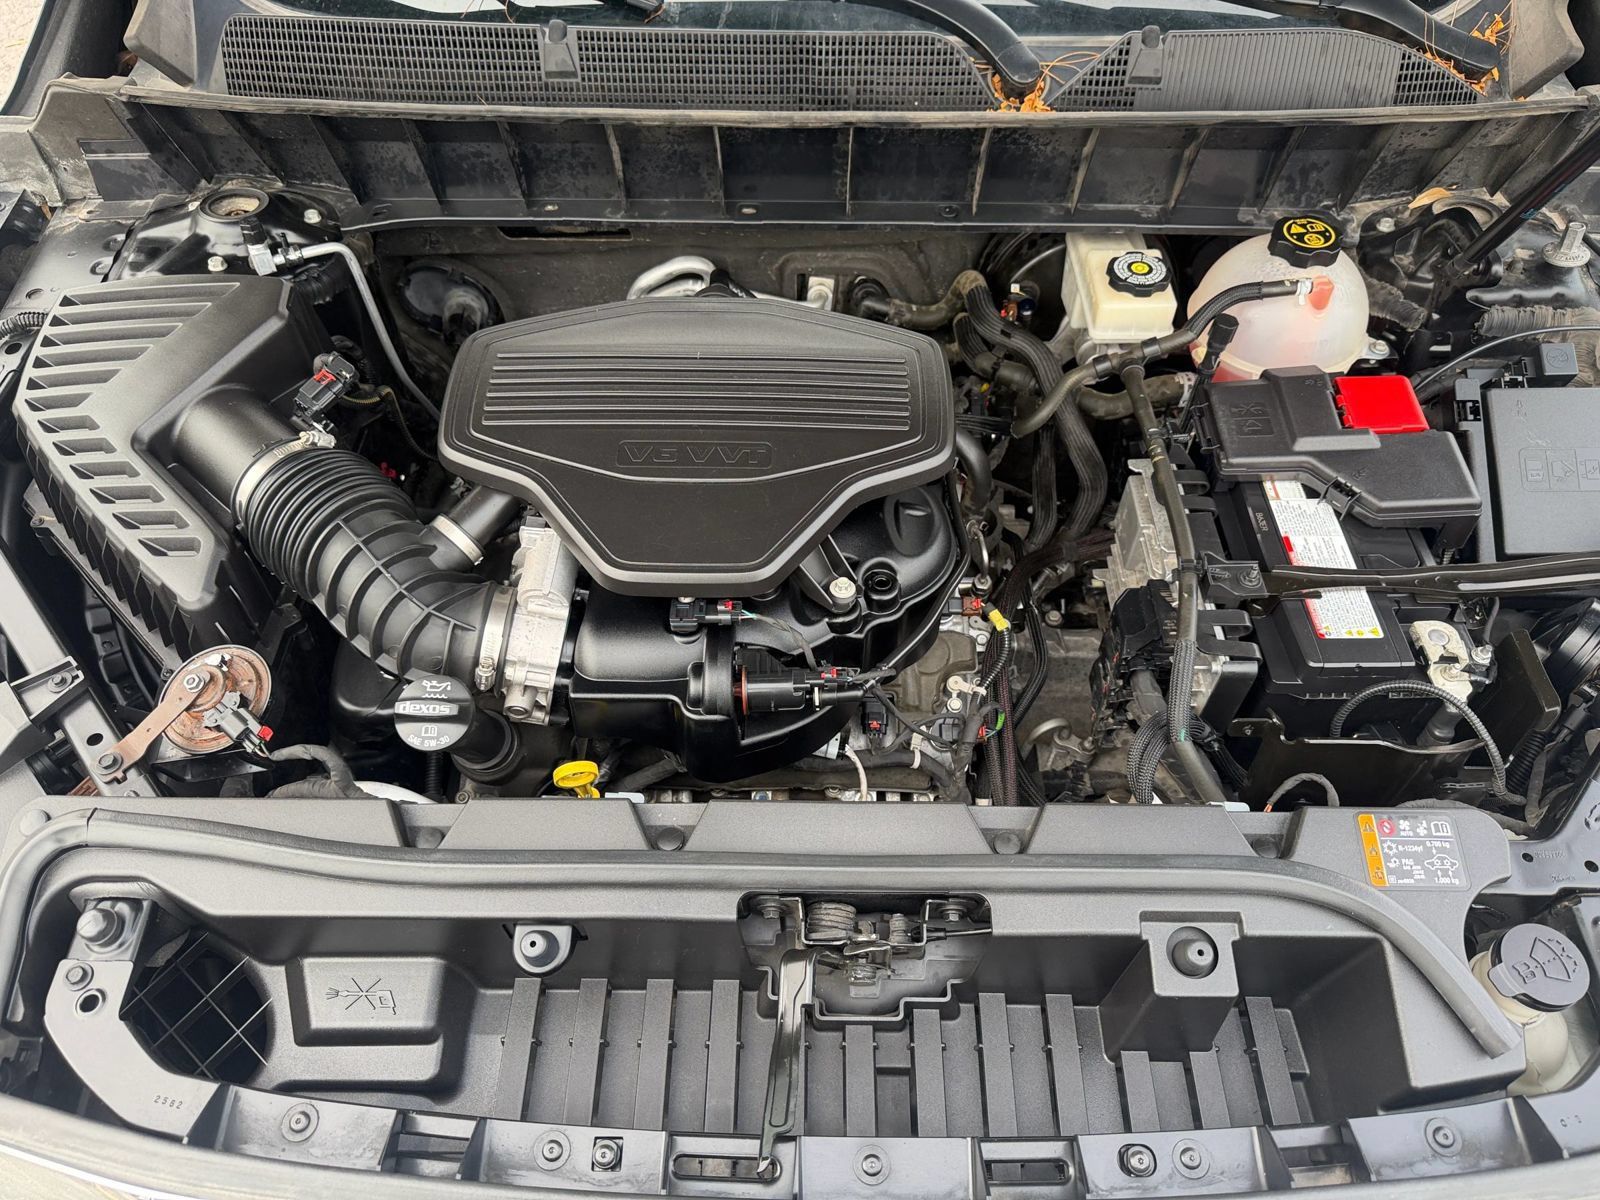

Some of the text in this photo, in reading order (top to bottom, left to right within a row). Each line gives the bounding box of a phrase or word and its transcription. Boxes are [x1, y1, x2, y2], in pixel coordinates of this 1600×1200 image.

[624, 445, 767, 464] V6 VVT
[399, 701, 452, 714] dexos
[408, 734, 450, 747] SAE 5W-30
